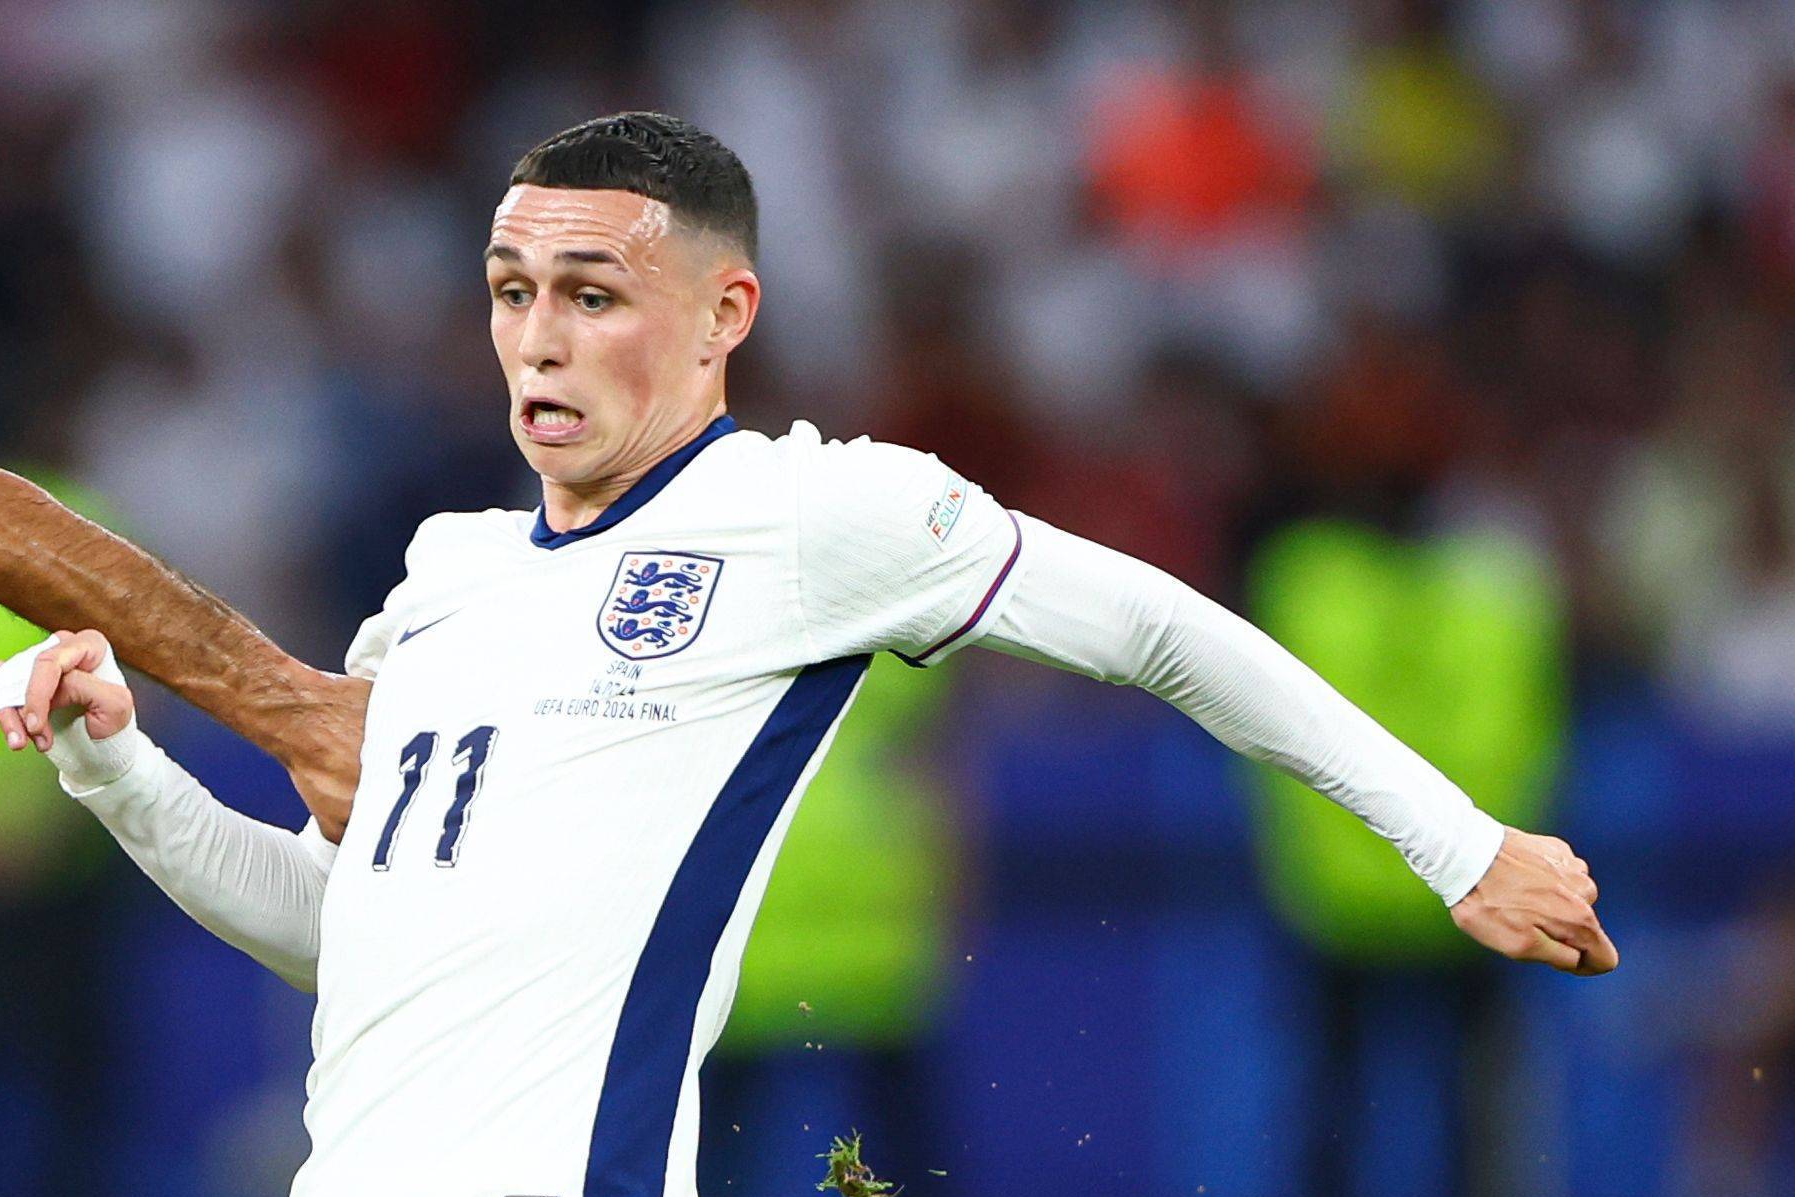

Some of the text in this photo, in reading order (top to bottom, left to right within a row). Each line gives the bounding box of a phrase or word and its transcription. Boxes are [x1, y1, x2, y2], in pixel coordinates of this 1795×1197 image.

[606, 659, 644, 681] SPAIN
[533, 698, 678, 722] UEFA EURO 2024 FINAL
[372, 725, 500, 872] 11
